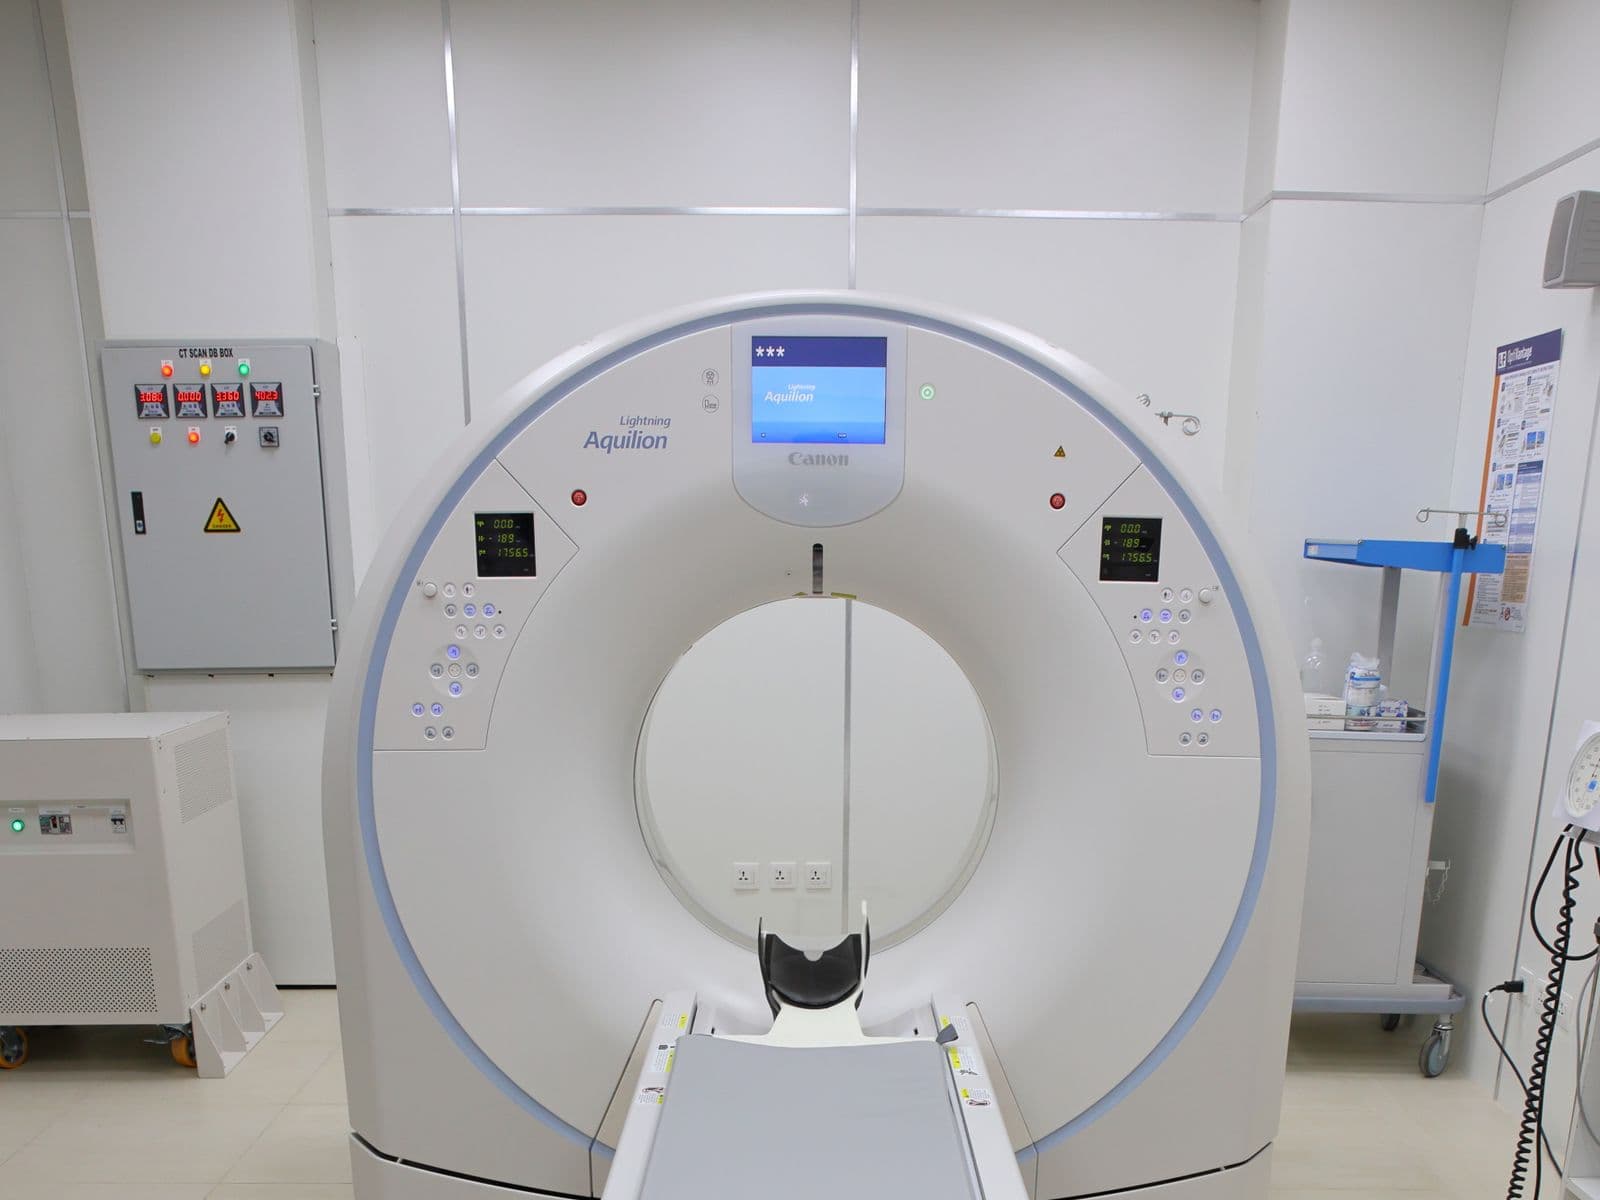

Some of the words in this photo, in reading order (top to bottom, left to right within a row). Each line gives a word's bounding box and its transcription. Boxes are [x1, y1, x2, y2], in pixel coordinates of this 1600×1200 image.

[178, 348, 187, 358] CT
[189, 348, 207, 358] SCAN
[209, 348, 218, 358] DB
[219, 348, 233, 358] BOX
[764, 391, 814, 405] Aquilion
[619, 415, 671, 429] Lightning
[583, 430, 668, 454] Aquilion
[788, 451, 849, 466] Canon
